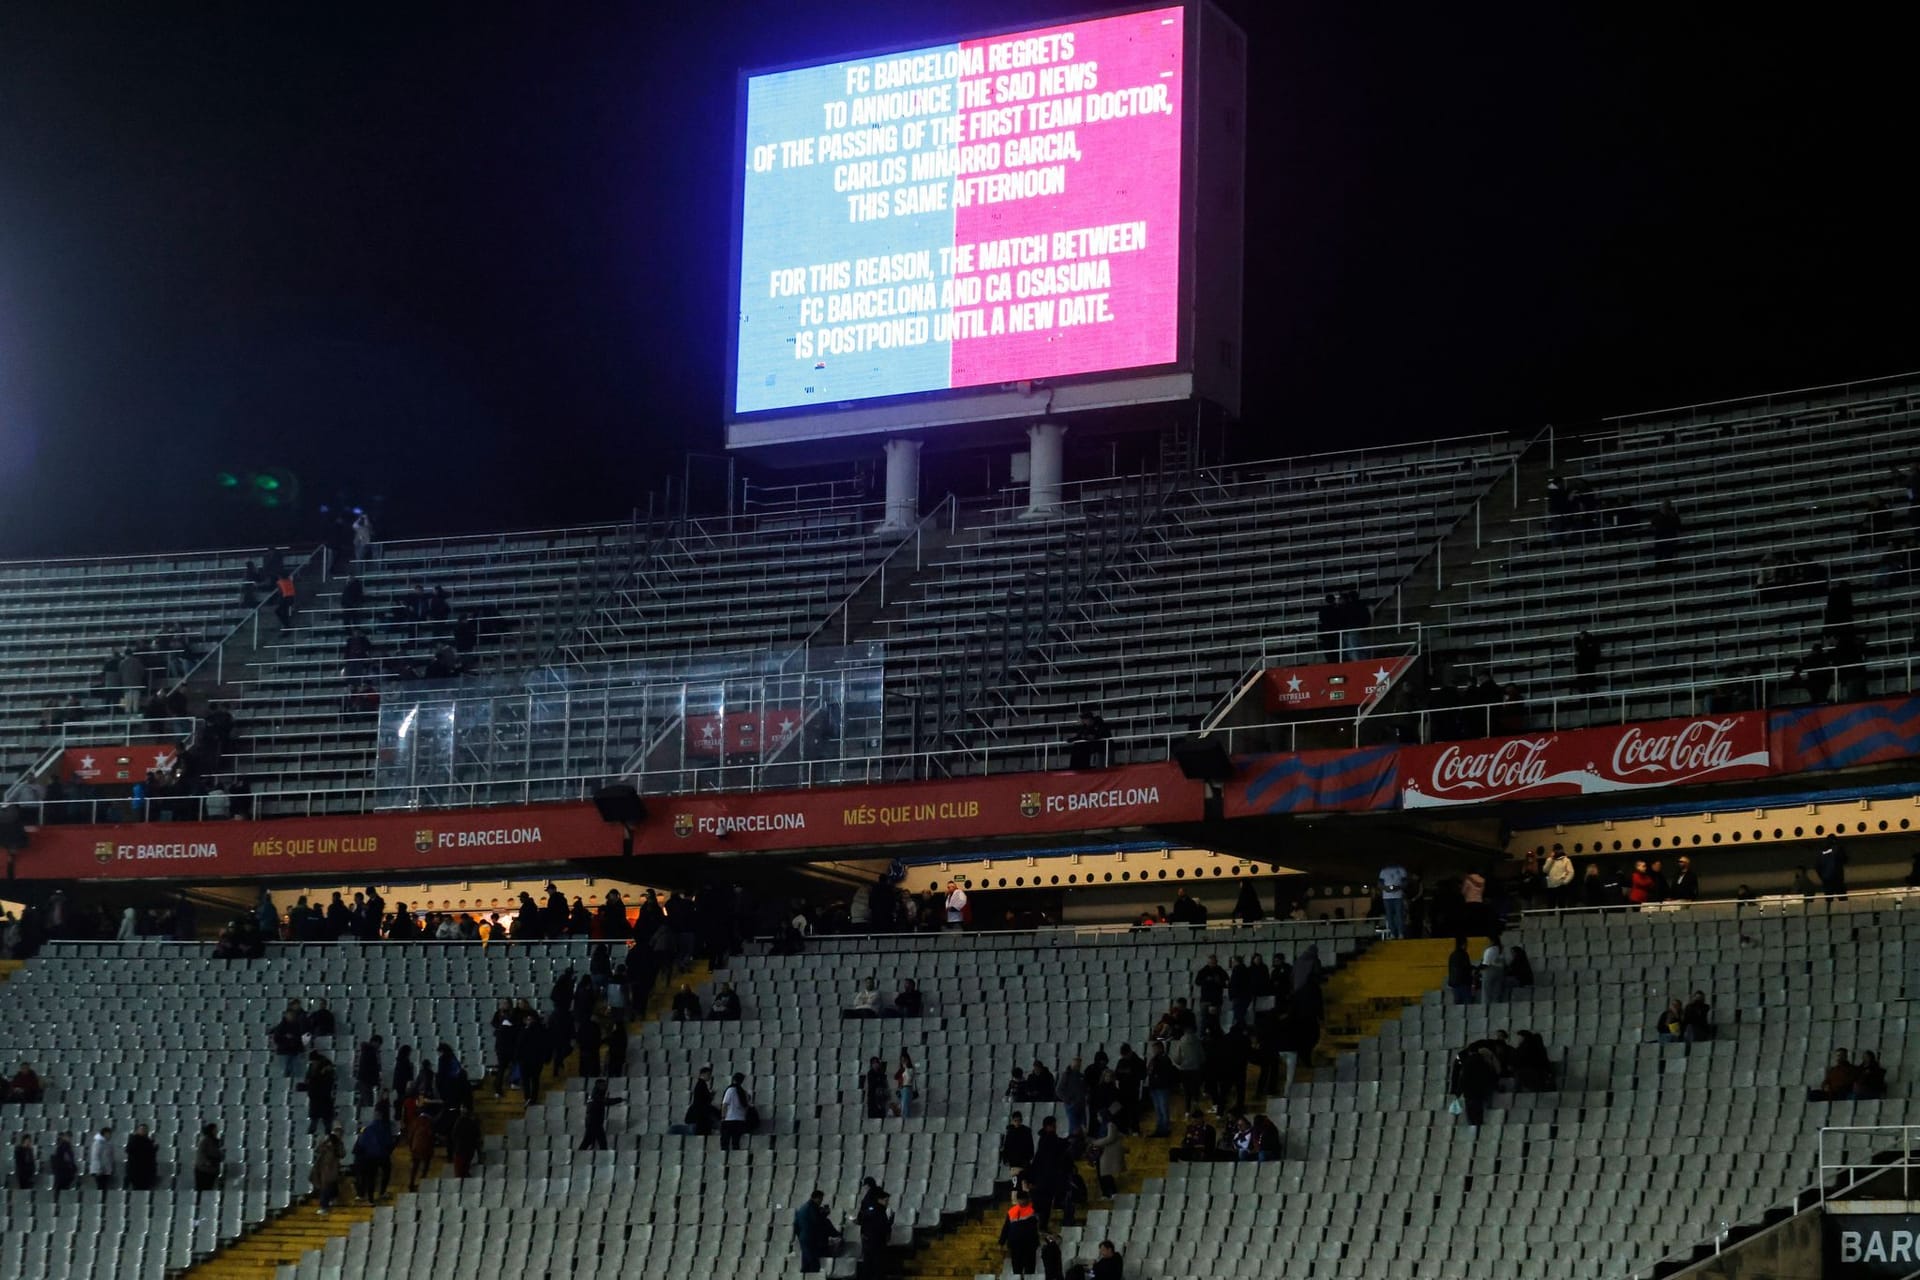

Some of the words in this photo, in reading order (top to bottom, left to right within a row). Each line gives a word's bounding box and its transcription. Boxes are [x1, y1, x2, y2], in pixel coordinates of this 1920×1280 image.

[846, 65, 870, 95] FC
[874, 47, 984, 90] BARCELONA
[988, 32, 1075, 72] REGRETS
[824, 101, 847, 130] TO
[851, 84, 952, 126] ANNOUNCE
[957, 77, 992, 109] THE
[995, 71, 1035, 103] SAD
[1039, 61, 1098, 97] NEWS
[753, 144, 778, 173] OF
[780, 137, 815, 169] THE
[818, 125, 898, 164] PASSING
[902, 120, 927, 150] OF
[930, 112, 966, 146] THE
[969, 105, 1024, 140] FIRST
[1027, 96, 1082, 131] TEAM
[1086, 84, 1173, 123] DOCTOR,
[833, 156, 907, 192] CARLOS
[911, 142, 1000, 181] MIÑARRO
[1004, 130, 1082, 168] GARCIA,
[847, 190, 890, 223] THIS
[894, 182, 948, 217] SAME
[951, 165, 1065, 208] AFTERNOON
[770, 267, 806, 298] FOR
[809, 261, 850, 293] THIS
[854, 250, 934, 287] REASON,
[938, 244, 976, 275] THE
[979, 234, 1048, 271] MATCH
[1052, 220, 1147, 261] BETWEEN
[800, 297, 824, 327] FC
[827, 282, 937, 323] BARCELONA
[941, 276, 981, 309] AND
[985, 273, 1013, 303] CA
[1016, 259, 1112, 298] OSASUNA
[795, 330, 813, 360] IS
[817, 316, 929, 357] POSTPONED
[933, 309, 988, 342] UNTIL
[991, 306, 1005, 336] A
[1008, 301, 1055, 333] NEW
[1058, 293, 1114, 327] DATE.
[1432, 738, 1553, 792] Coca-Cola
[1612, 718, 1739, 776] Coca-Cola
[698, 817, 715, 833] FC
[844, 804, 876, 825] MÉS
[880, 806, 911, 827] QUE
[915, 804, 935, 821] UN
[940, 801, 979, 819] CLUB
[1046, 796, 1064, 813] FC
[1068, 787, 1159, 811] BARCELONA
[117, 845, 135, 860] FC
[136, 843, 218, 859] BARCELONA
[253, 837, 283, 857] MÉS
[286, 839, 315, 857] QUE
[318, 838, 338, 853] UN
[342, 837, 377, 853] CLUB
[438, 832, 455, 848] FC
[458, 827, 542, 847] BARCELONA
